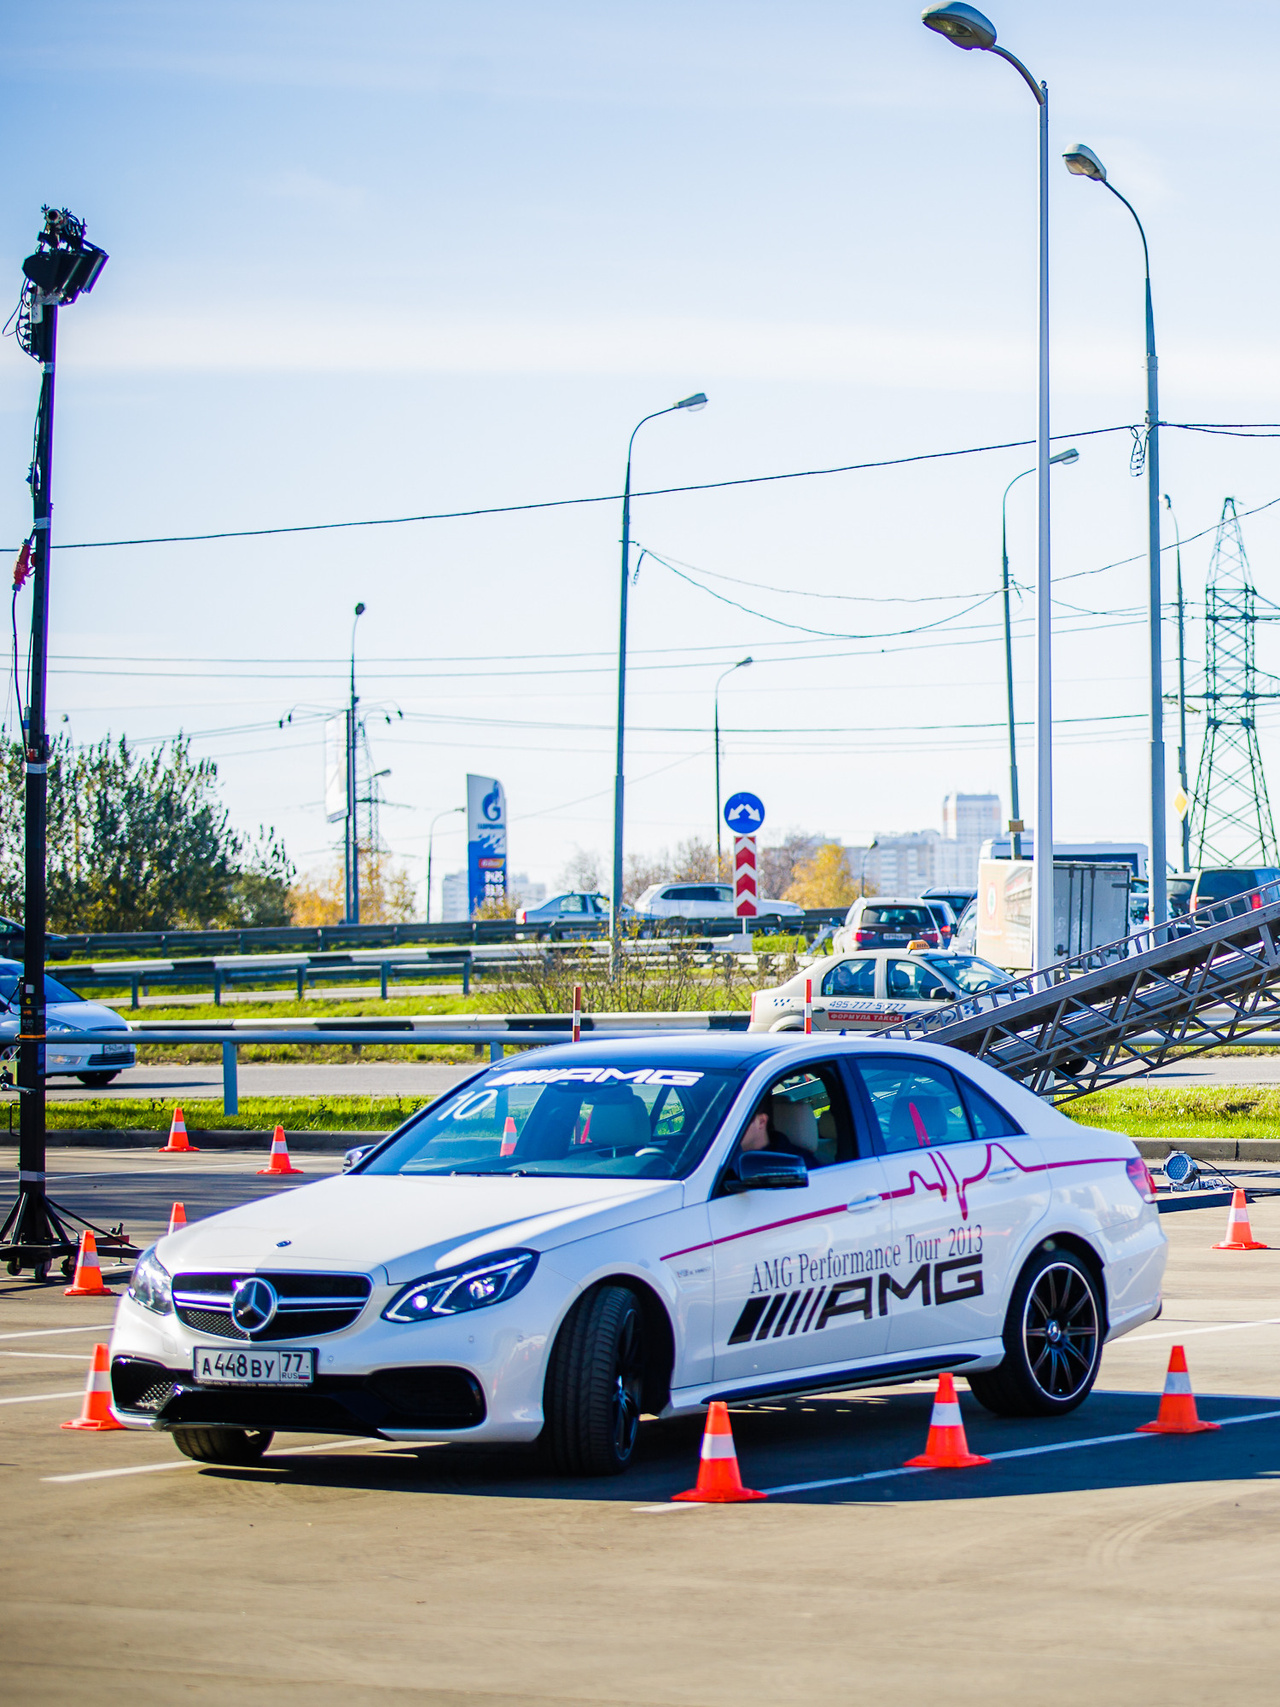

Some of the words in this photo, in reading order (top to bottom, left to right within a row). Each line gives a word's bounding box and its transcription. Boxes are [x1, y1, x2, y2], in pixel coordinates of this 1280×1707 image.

[830, 1013, 872, 1021] ФОРМУЛА
[438, 1088, 499, 1121] 10
[750, 1255, 793, 1294] AMG
[798, 1245, 901, 1284] Performance
[905, 1233, 941, 1264] Tour
[948, 1223, 983, 1256] 2013
[814, 1253, 984, 1331] AMG
[202, 1353, 275, 1378] А448ВУ
[281, 1353, 304, 1373] 77
[281, 1371, 298, 1380] RUS
